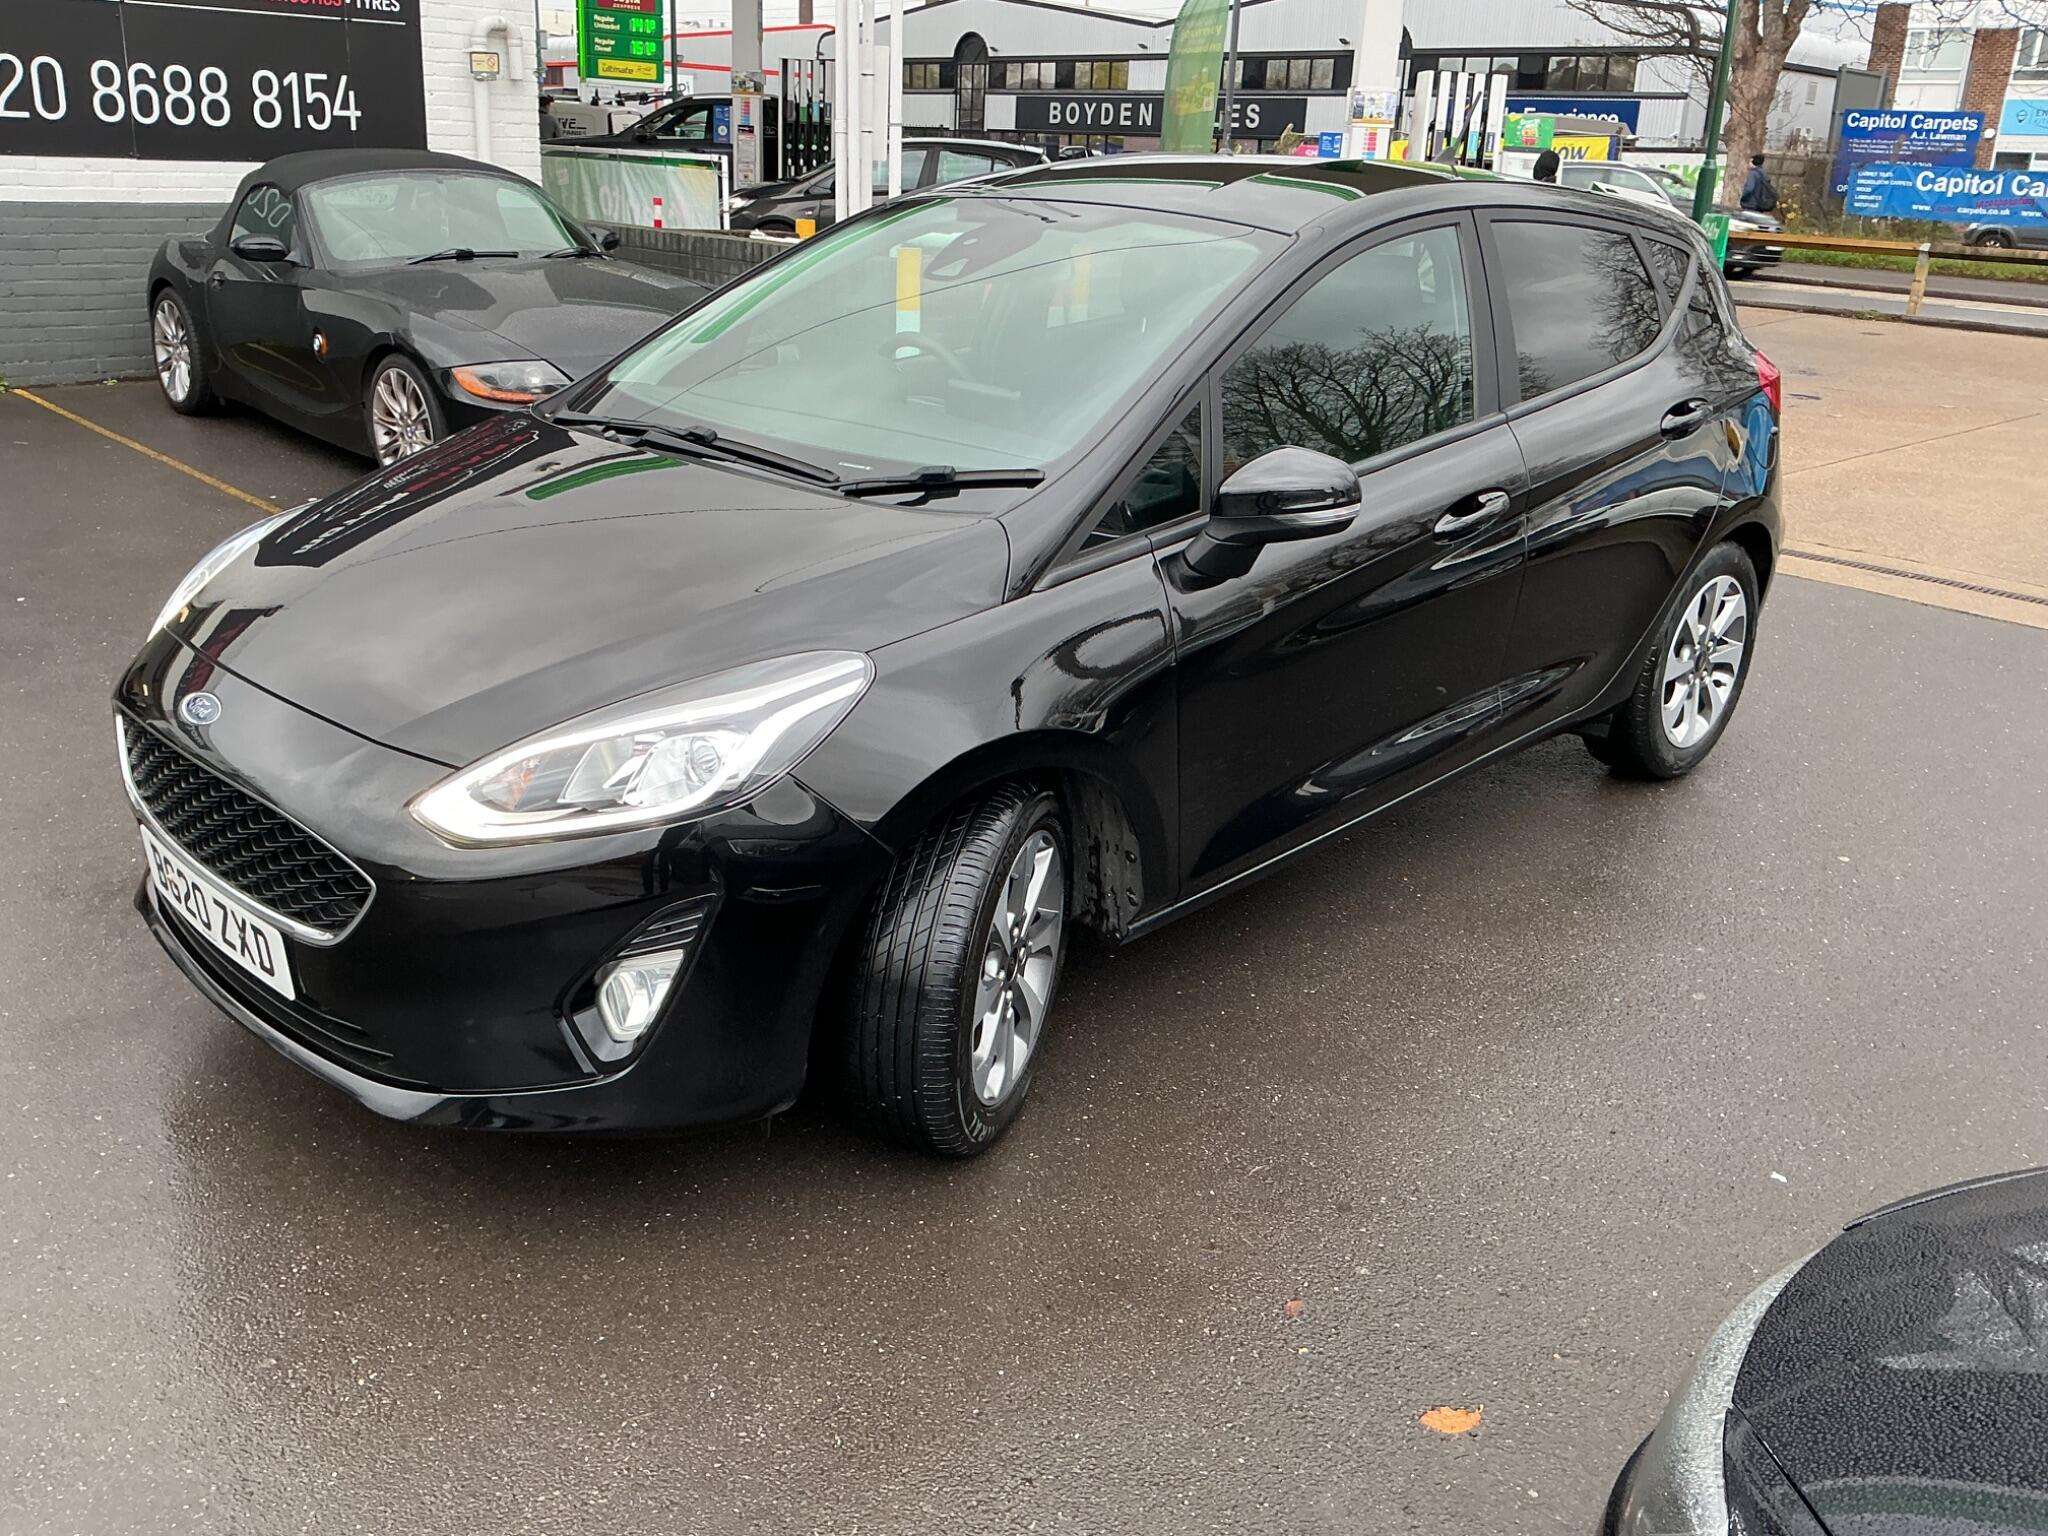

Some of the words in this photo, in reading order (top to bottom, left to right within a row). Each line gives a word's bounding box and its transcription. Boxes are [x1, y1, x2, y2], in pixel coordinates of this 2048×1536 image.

[91, 60, 232, 128] 8688
[252, 69, 363, 131] 8154
[1049, 102, 1153, 126] BOYDEN
[1847, 112, 1907, 131] Capitol
[1911, 114, 1978, 133] Carpets
[1916, 170, 2003, 198] Capitol
[212, 897, 275, 978] ZXD
